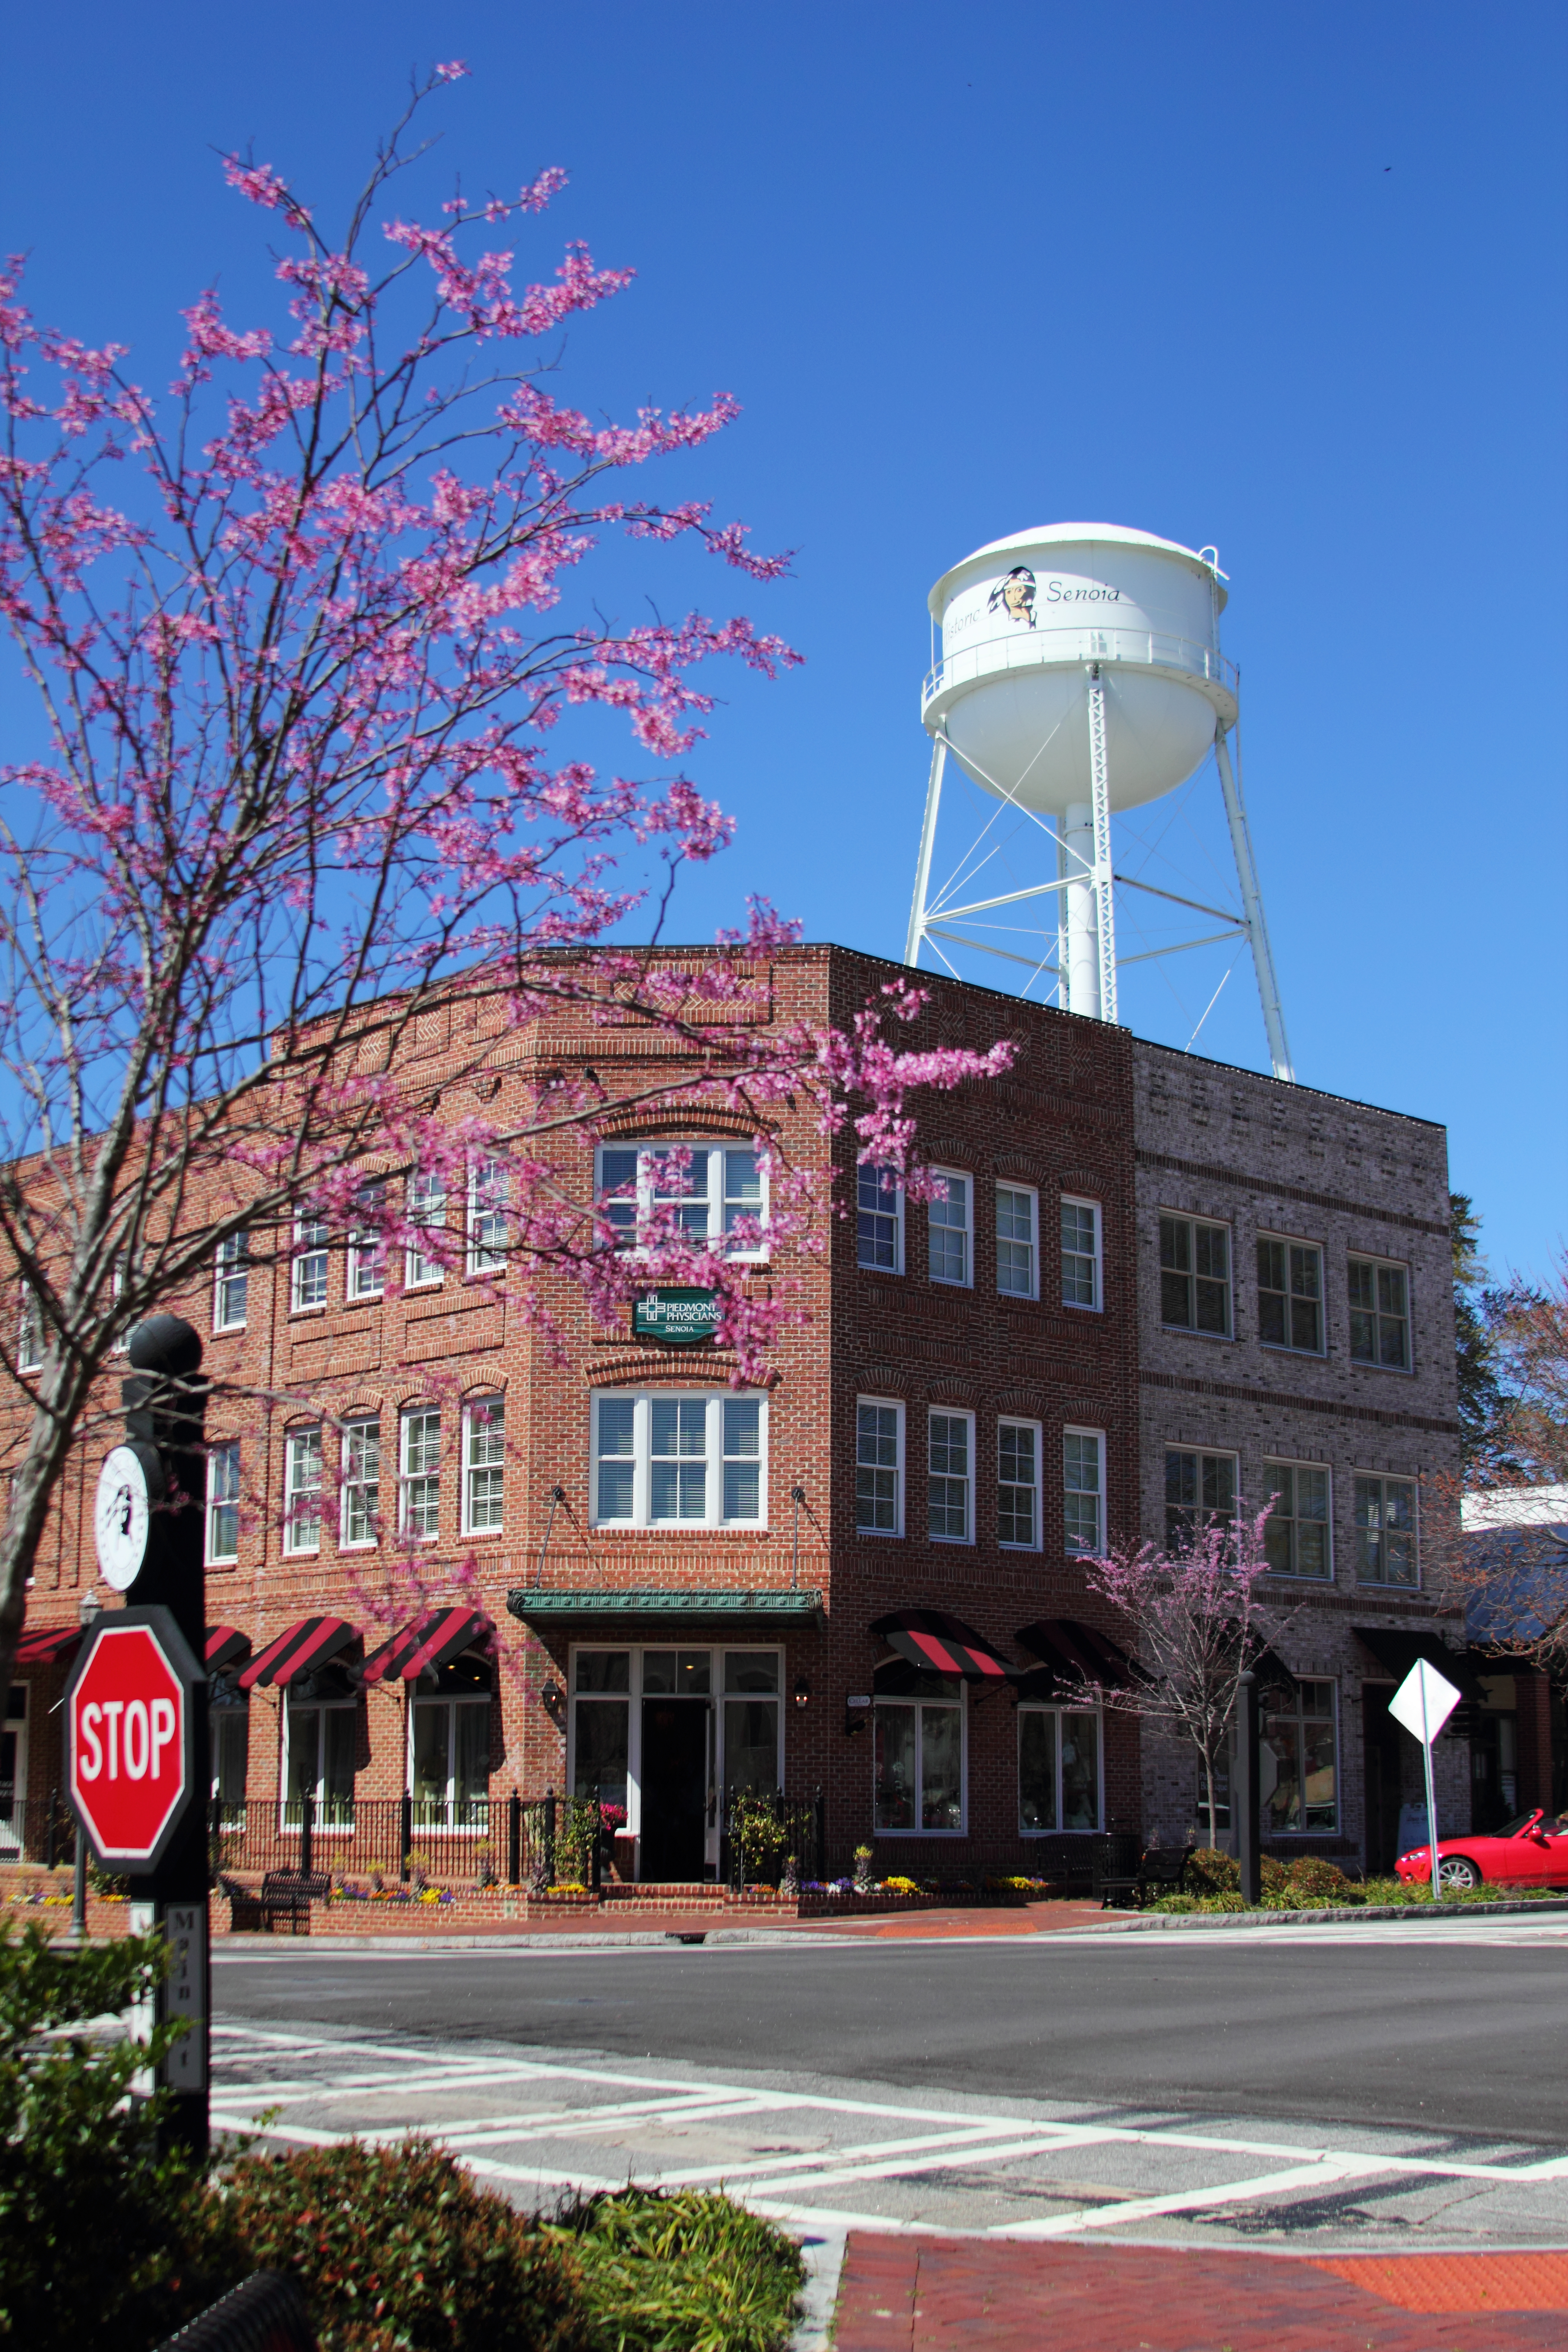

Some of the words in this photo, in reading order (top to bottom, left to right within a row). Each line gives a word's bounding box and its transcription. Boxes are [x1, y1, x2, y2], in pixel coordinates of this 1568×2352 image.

[1047, 581, 1120, 602] Senoia
[944, 608, 980, 645] Historic
[667, 1303, 716, 1312] PIEDMONT
[667, 1312, 722, 1321] PHYSICIANS
[79, 1698, 176, 1781] STOP
[1200, 1781, 1227, 1792] Boique
[173, 1910, 194, 2000] Main
